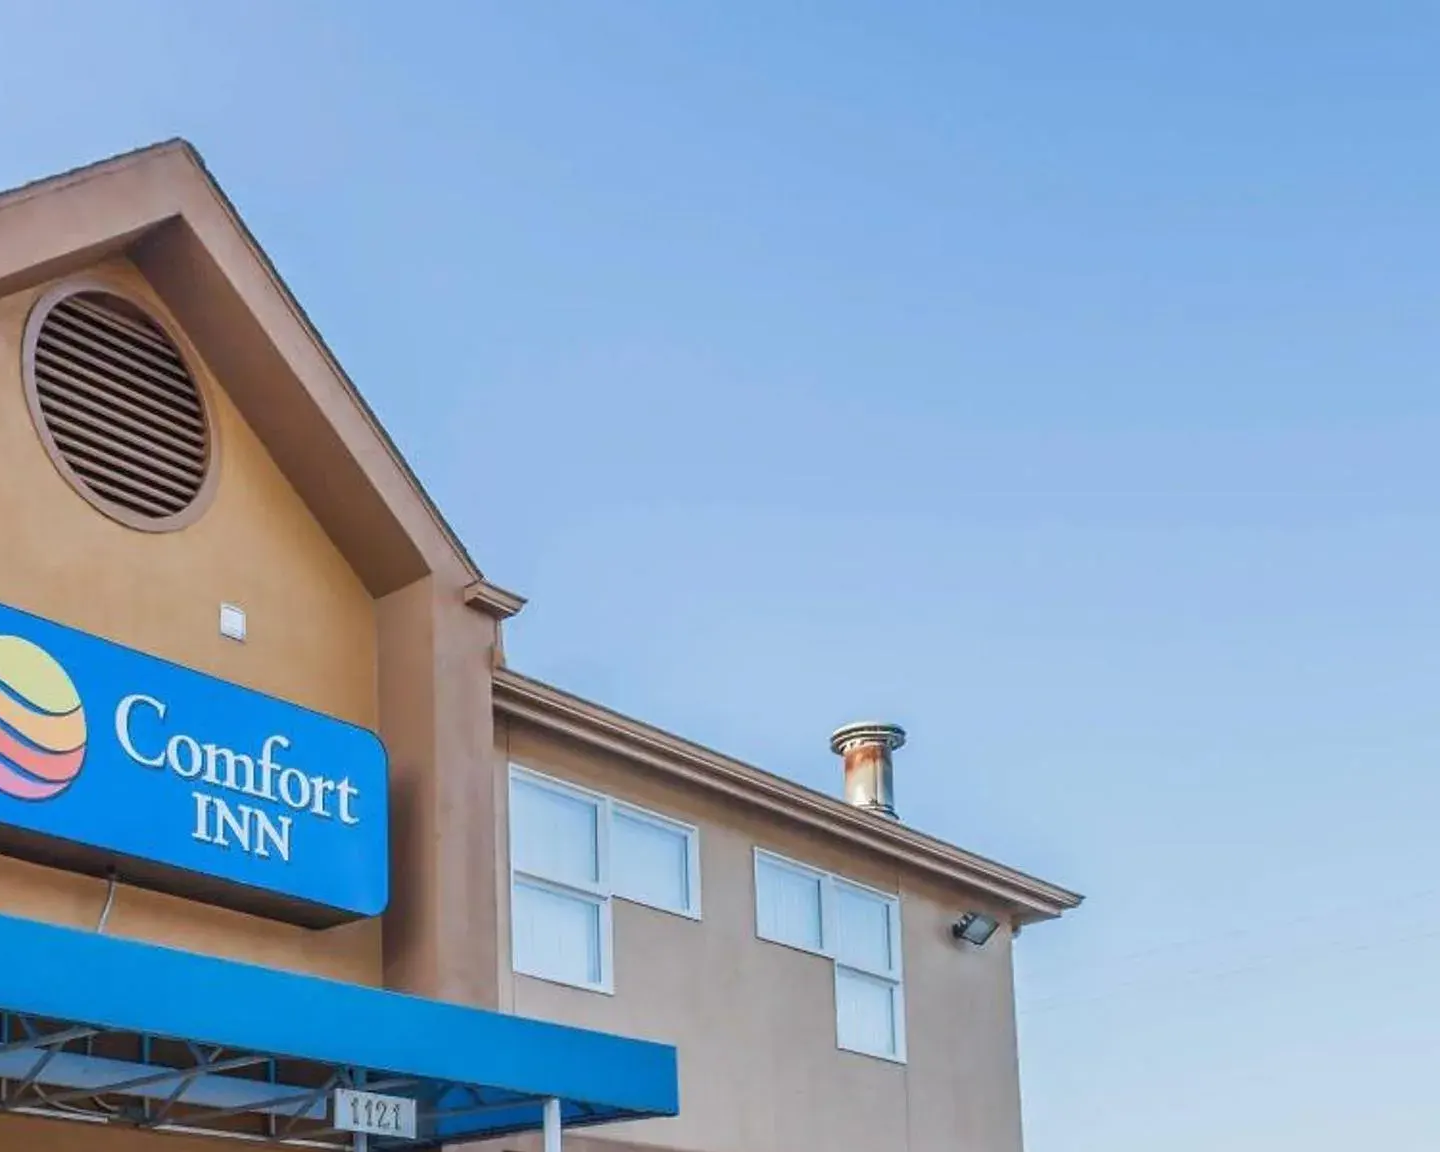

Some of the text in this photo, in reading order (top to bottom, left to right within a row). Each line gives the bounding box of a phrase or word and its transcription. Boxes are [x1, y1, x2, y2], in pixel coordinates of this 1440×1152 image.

[115, 694, 360, 825] Comfort
[192, 792, 293, 862] INN
[351, 1096, 401, 1131] 1121
